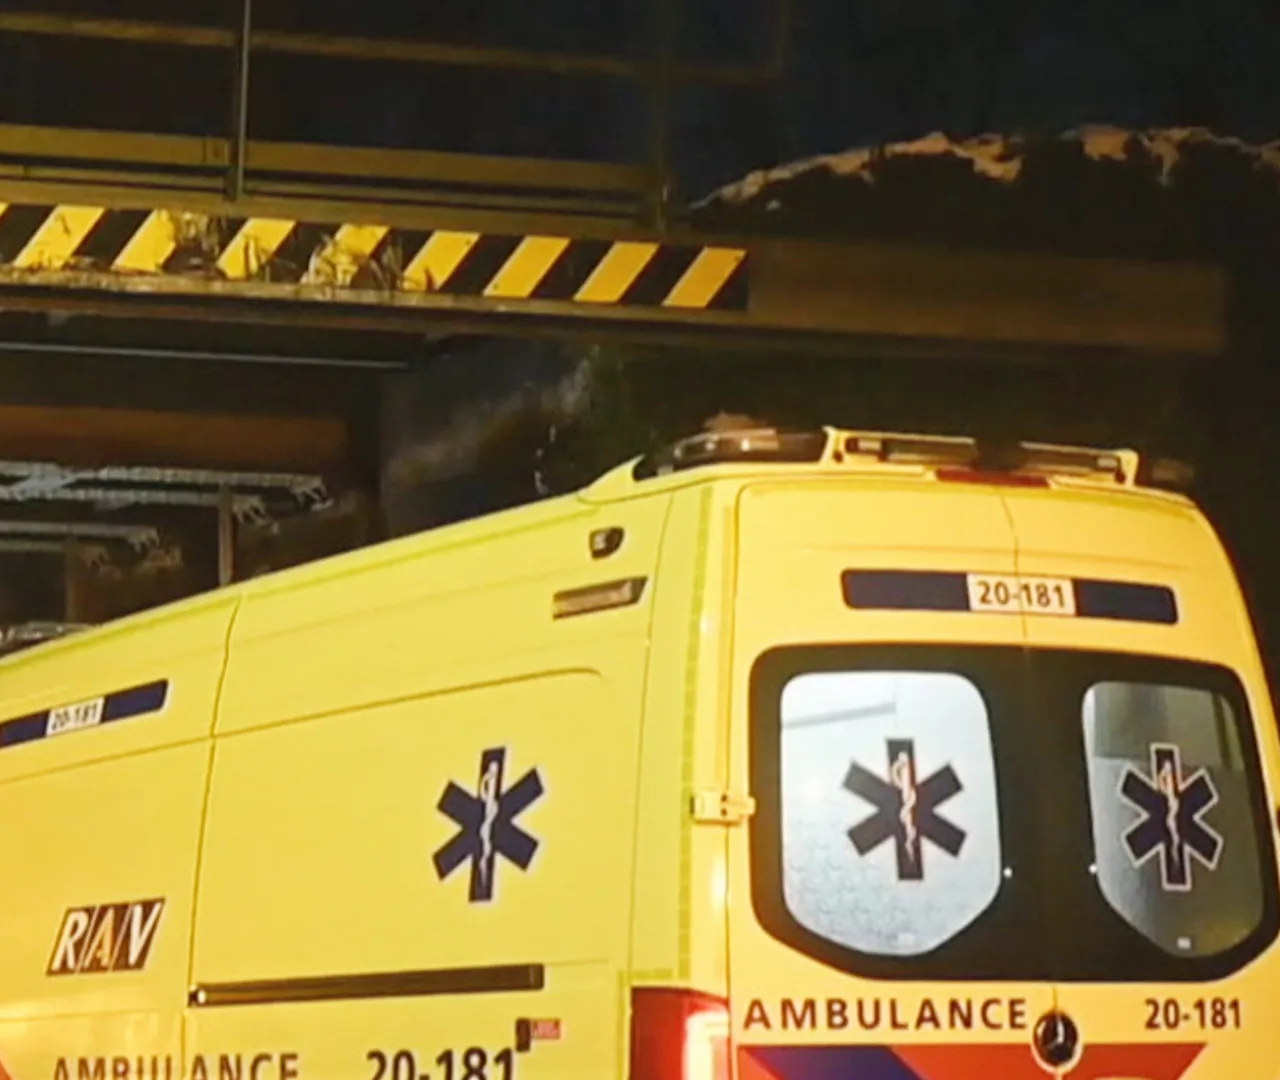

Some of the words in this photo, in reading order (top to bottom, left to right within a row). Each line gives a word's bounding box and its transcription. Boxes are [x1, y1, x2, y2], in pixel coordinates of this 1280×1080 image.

[976, 580, 1065, 608] 20-181
[49, 900, 162, 973] RAV
[742, 998, 1028, 1031] AMBULANCE
[1144, 996, 1241, 1031] 20-181
